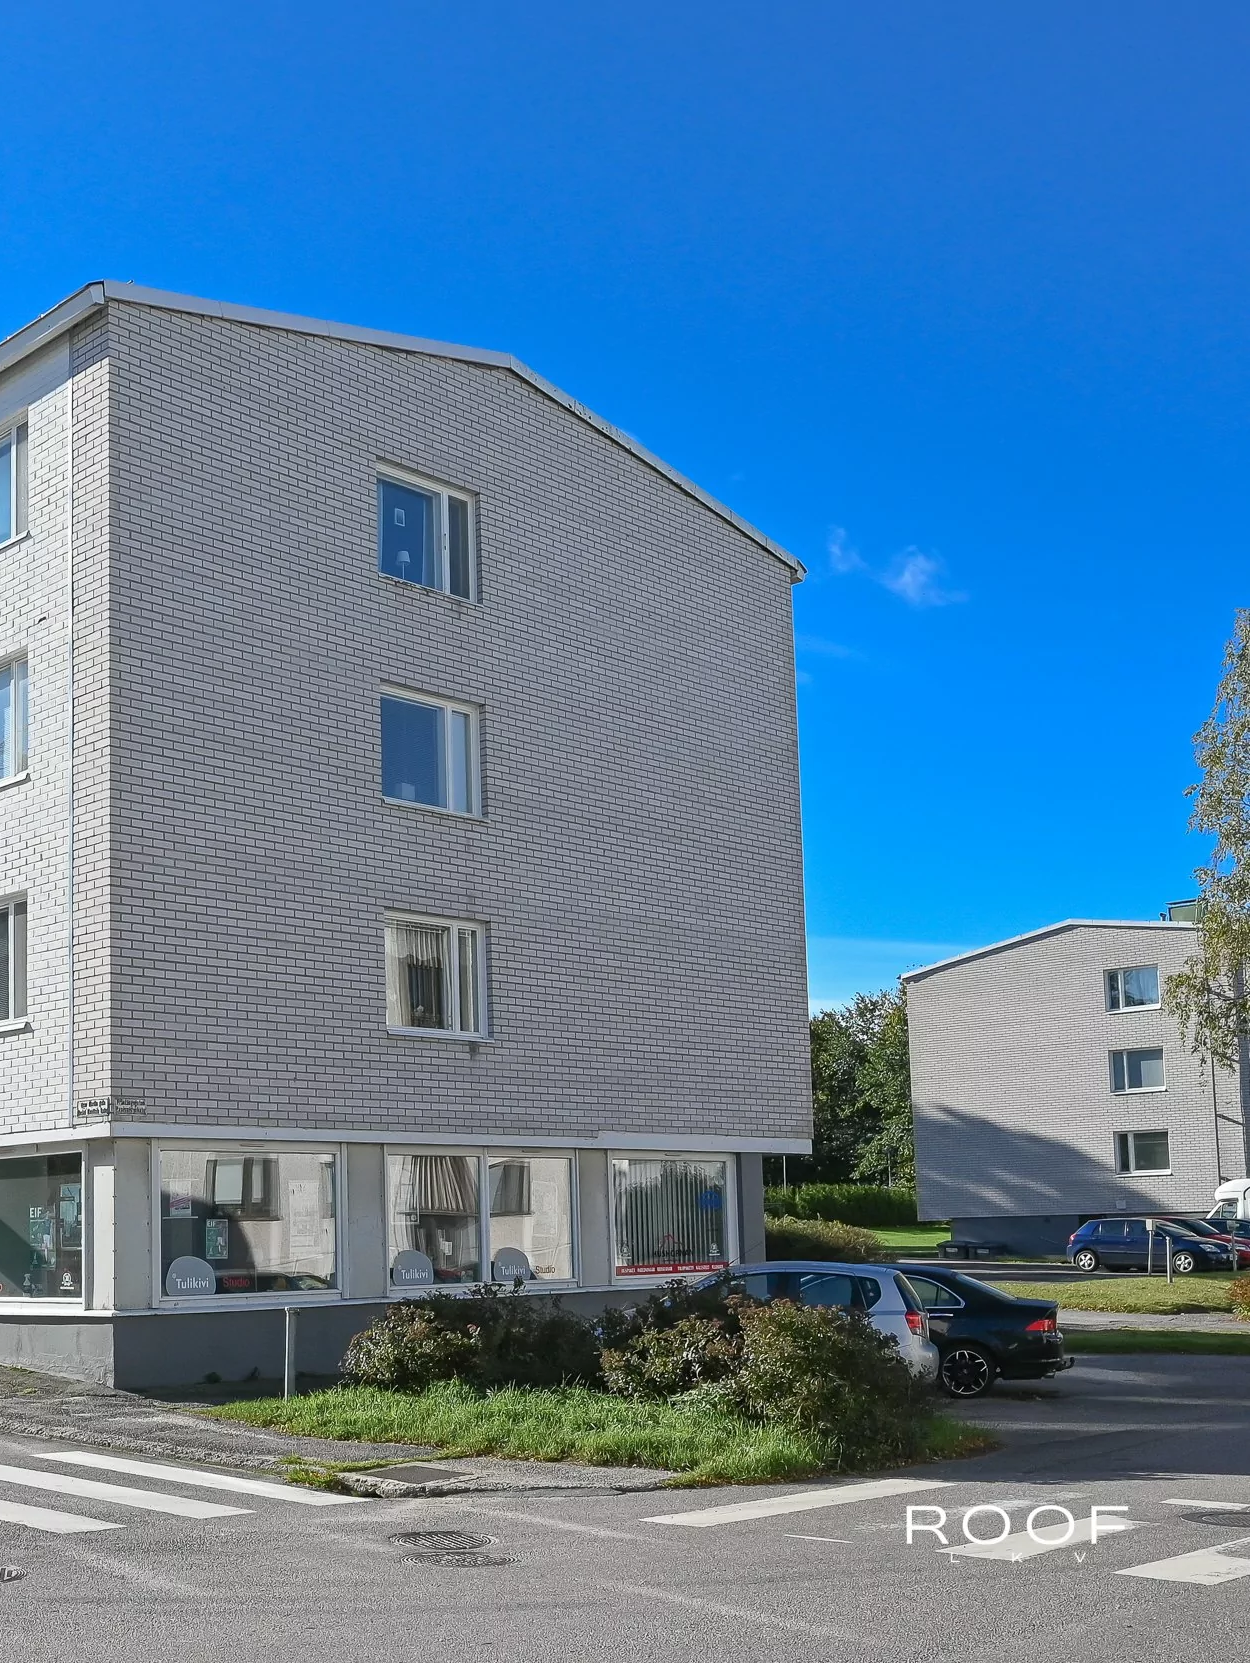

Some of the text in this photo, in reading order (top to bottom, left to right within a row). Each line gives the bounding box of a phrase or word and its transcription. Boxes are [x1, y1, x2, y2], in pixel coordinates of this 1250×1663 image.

[29, 1206, 43, 1219] EIF
[401, 1268, 429, 1280] Tulikivi
[500, 1264, 556, 1276] Tulikivi Studio
[175, 1277, 250, 1289] Tulikivi Studio
